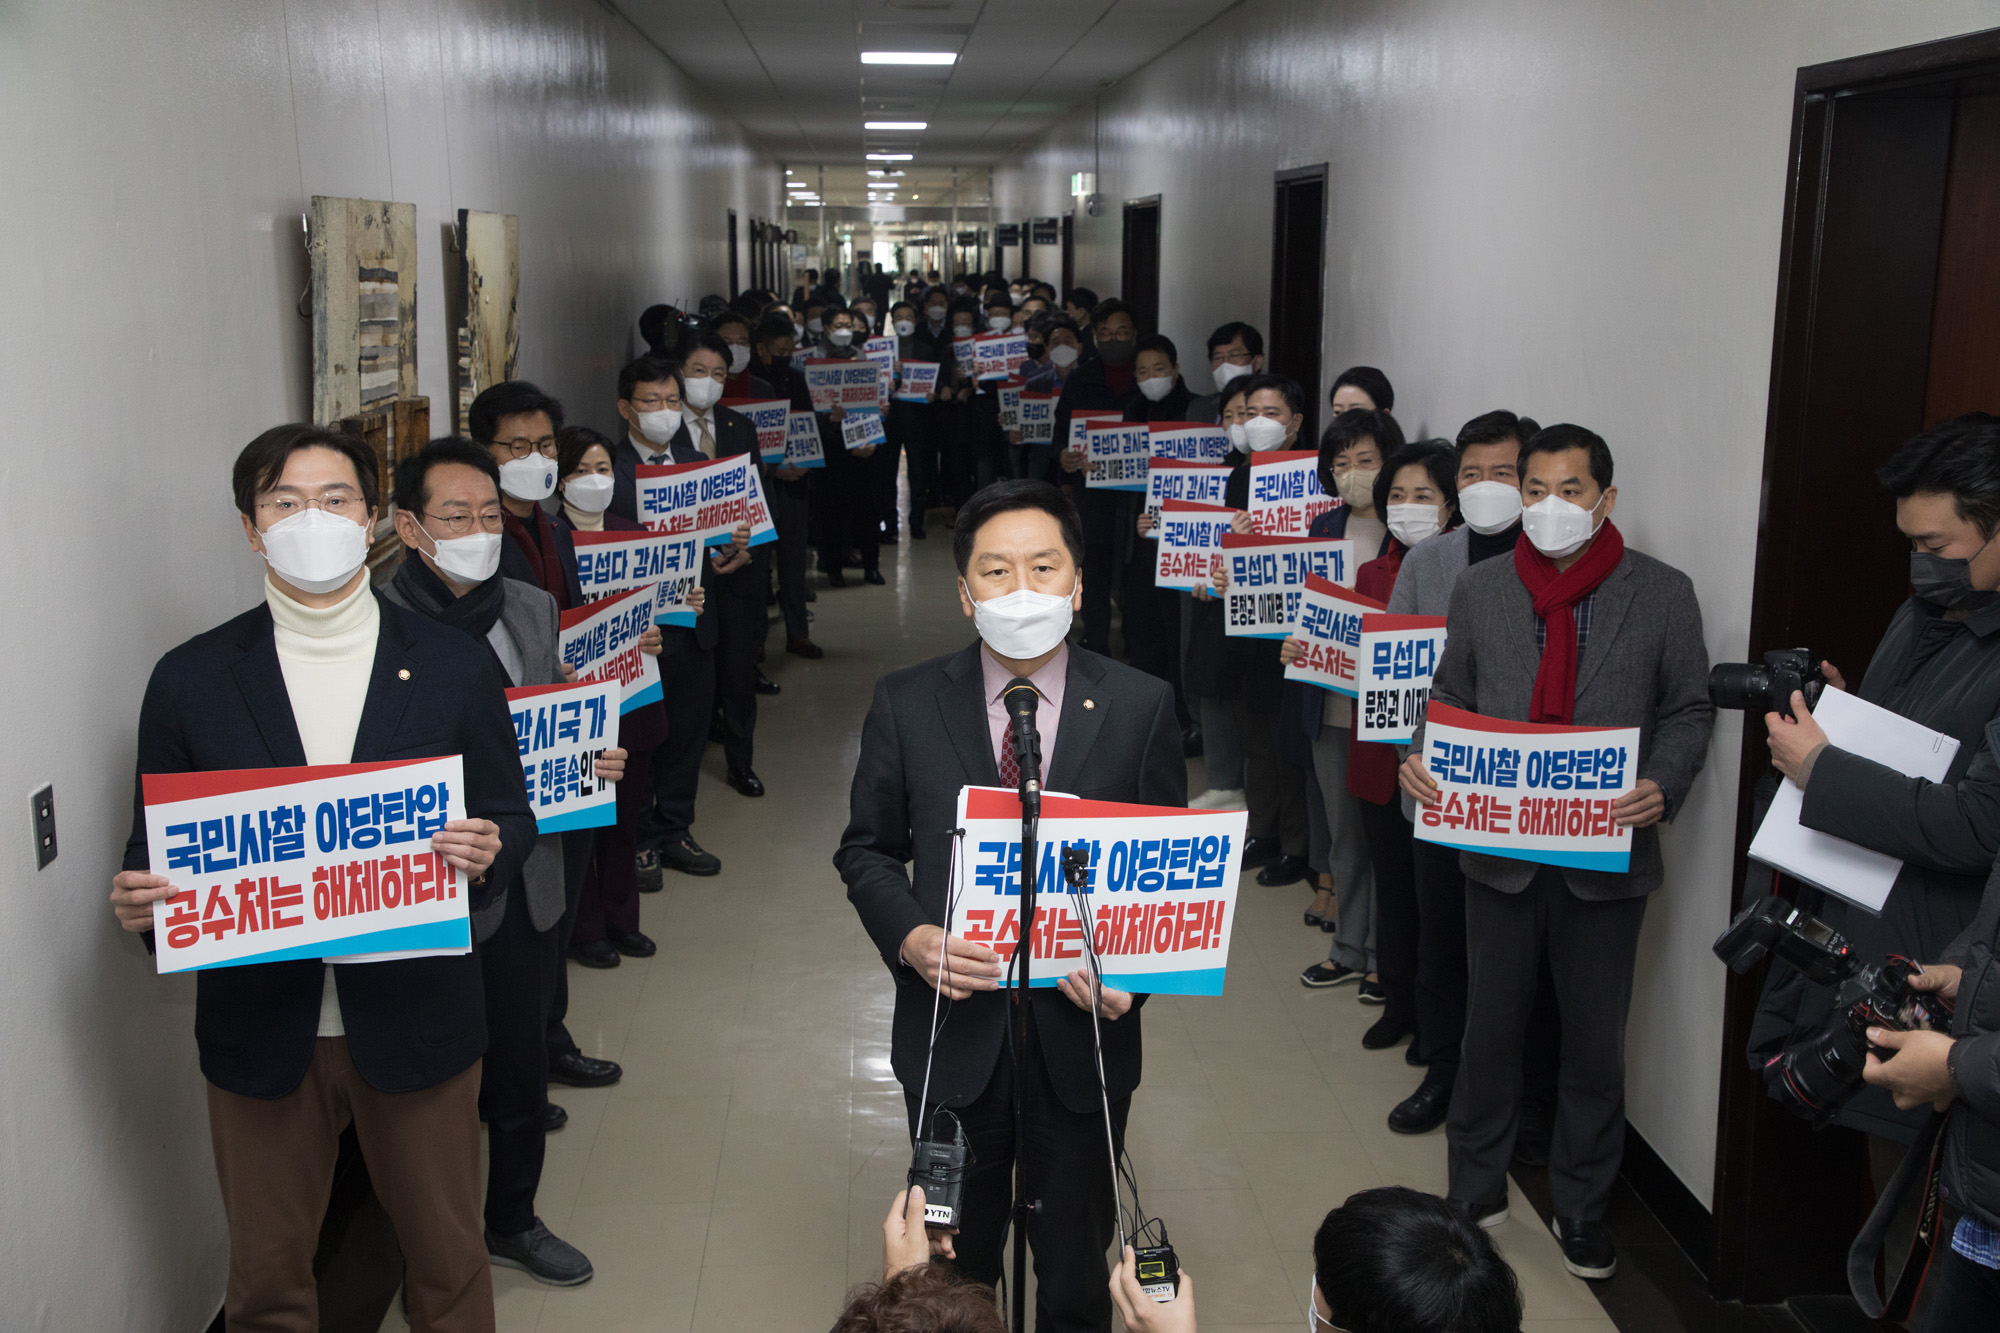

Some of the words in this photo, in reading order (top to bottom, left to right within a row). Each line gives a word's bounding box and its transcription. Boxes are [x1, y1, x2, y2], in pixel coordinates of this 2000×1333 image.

[1003, 392, 1019, 407] 무섭
[1023, 404, 1050, 420] 무섭다
[754, 408, 786, 428] 야당탄압
[788, 416, 814, 436] 시국가
[1092, 434, 1119, 456] 무섭다
[1122, 432, 1149, 453] 감시국
[1155, 436, 1198, 460] 국민사찰
[644, 478, 698, 514] 국민사찰
[701, 465, 747, 502] 야당탄압
[1152, 475, 1184, 499] 무섭다
[1255, 470, 1305, 502] 국민사찰
[696, 496, 747, 530] 해체하라!
[1252, 506, 1302, 535] 공수처는
[1164, 522, 1211, 548] 국민사찰
[578, 550, 628, 586] 무섭다
[633, 540, 696, 579] 감시국가
[1160, 552, 1207, 578] 공수처는
[1232, 554, 1278, 587] 무섭다
[1282, 550, 1344, 585] 감시국가
[1231, 594, 1256, 626] 문정권
[1301, 602, 1362, 648] 국민사찰
[564, 620, 608, 670] 불법사찰
[609, 599, 652, 650] 공수처장
[1292, 639, 1356, 681] 공수처는
[1372, 638, 1436, 680] 무섭다
[1365, 688, 1400, 729] 문정권
[1404, 687, 1432, 727] 이재
[1430, 740, 1520, 788] 국민사찰
[1526, 746, 1626, 790] 야당탄압
[166, 804, 305, 874] 국민사찰
[316, 782, 450, 854] 야당탄압
[1422, 790, 1512, 834] 공수처는
[975, 838, 1102, 896] 국민사찰
[1107, 834, 1231, 892] 야당탄압
[165, 876, 304, 949] 공수처는
[312, 852, 456, 920] 해체하라!
[964, 906, 1085, 963] 공수처는
[1092, 900, 1226, 956] 해체하라!
[930, 1209, 950, 1218] YTN
